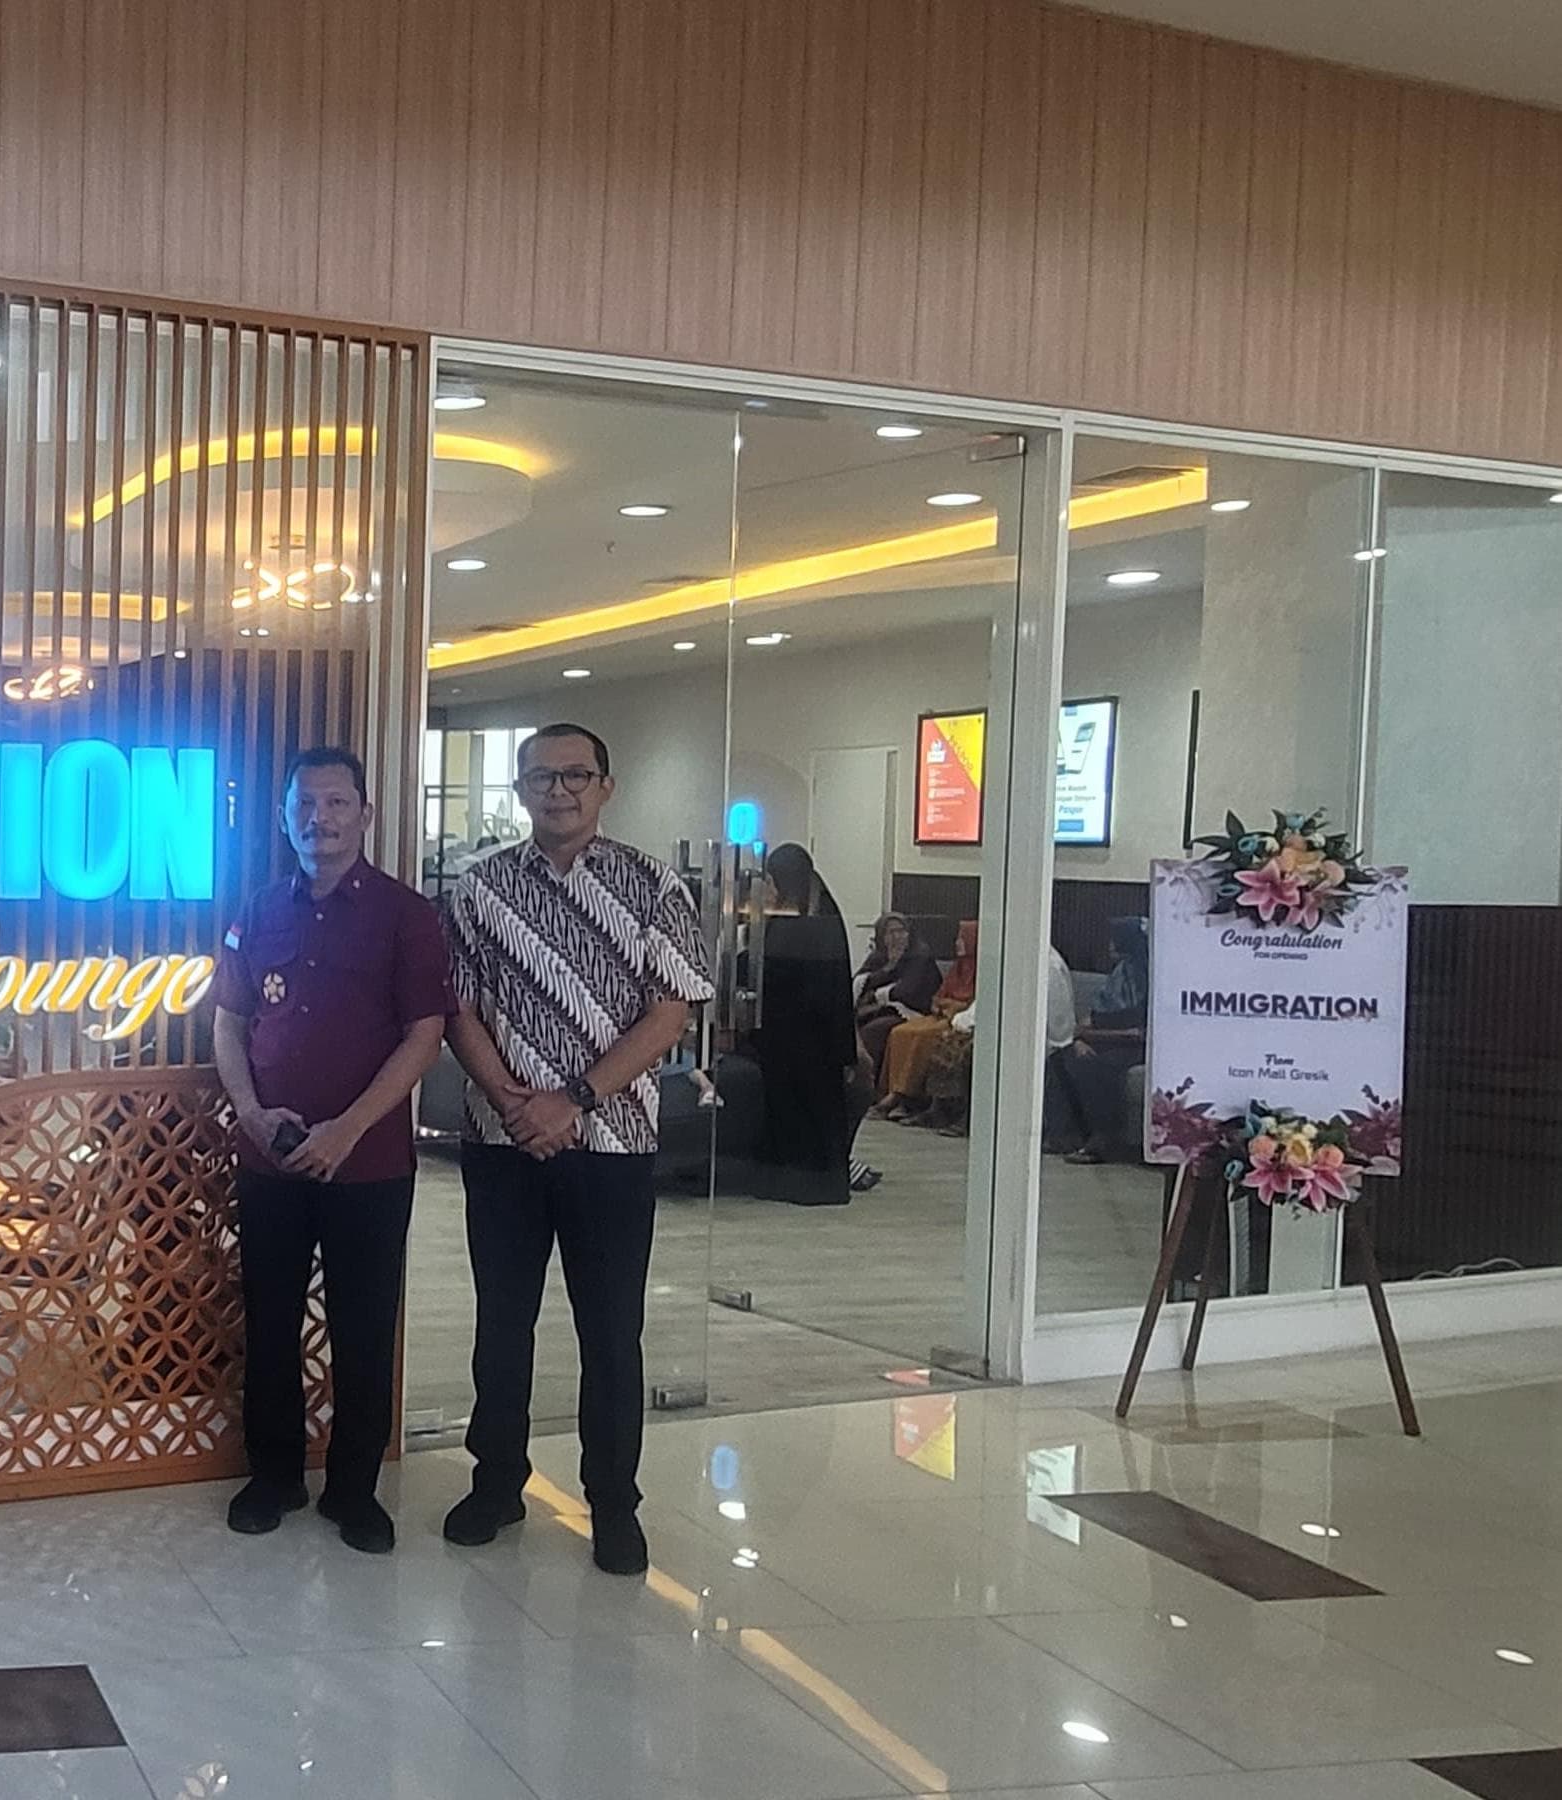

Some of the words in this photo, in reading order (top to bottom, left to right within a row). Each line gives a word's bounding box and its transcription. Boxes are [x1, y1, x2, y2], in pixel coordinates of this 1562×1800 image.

[1220, 928, 1343, 951] Congratulation
[1181, 990, 1379, 1018] IMMIGRATION
[1264, 1053, 1294, 1066] From
[1228, 1066, 1254, 1079] Icon
[1257, 1066, 1287, 1080] Mall
[1290, 1068, 1329, 1082] Gresik
